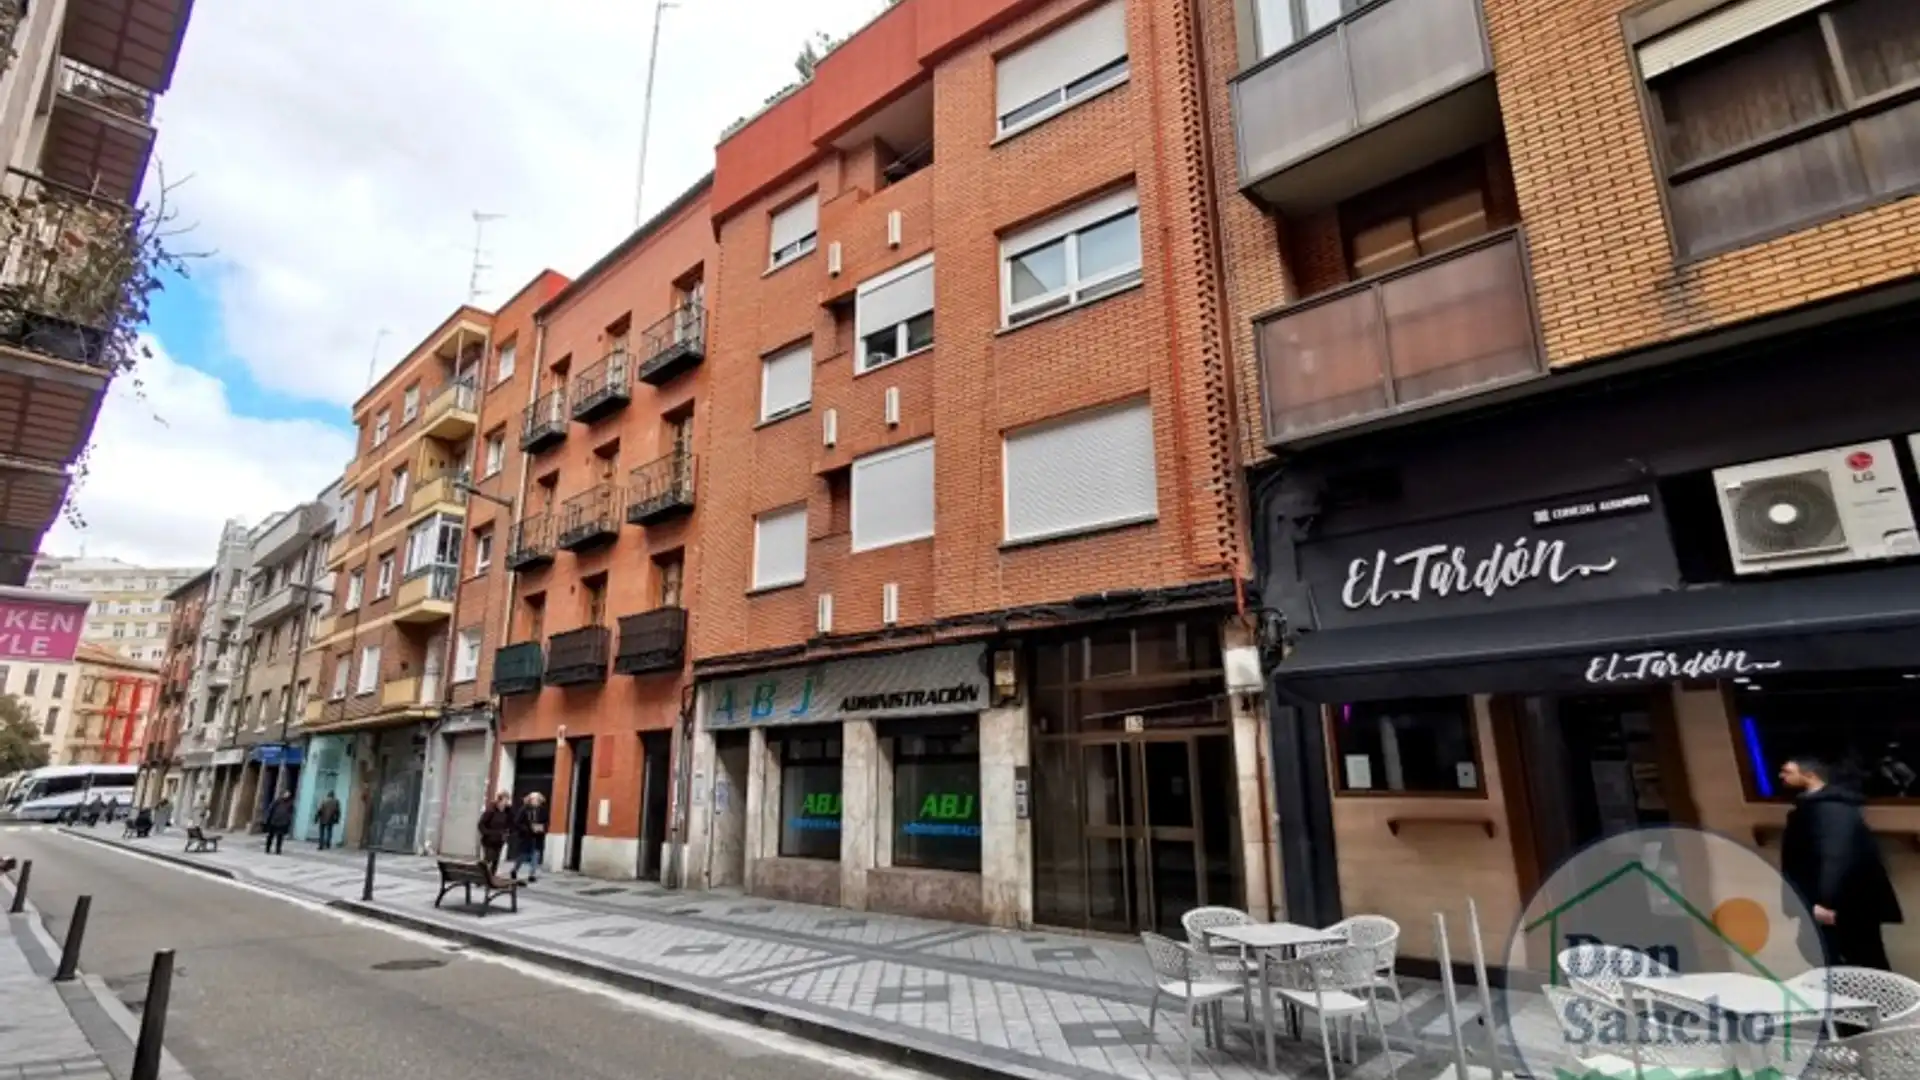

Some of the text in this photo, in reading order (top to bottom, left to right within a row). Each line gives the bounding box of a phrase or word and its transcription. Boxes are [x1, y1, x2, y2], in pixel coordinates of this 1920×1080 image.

[1853, 471, 1876, 484] LG
[0, 609, 75, 633] KEN
[838, 682, 981, 713] ADMINISTRACIÓN
[919, 793, 974, 819] ABJ
